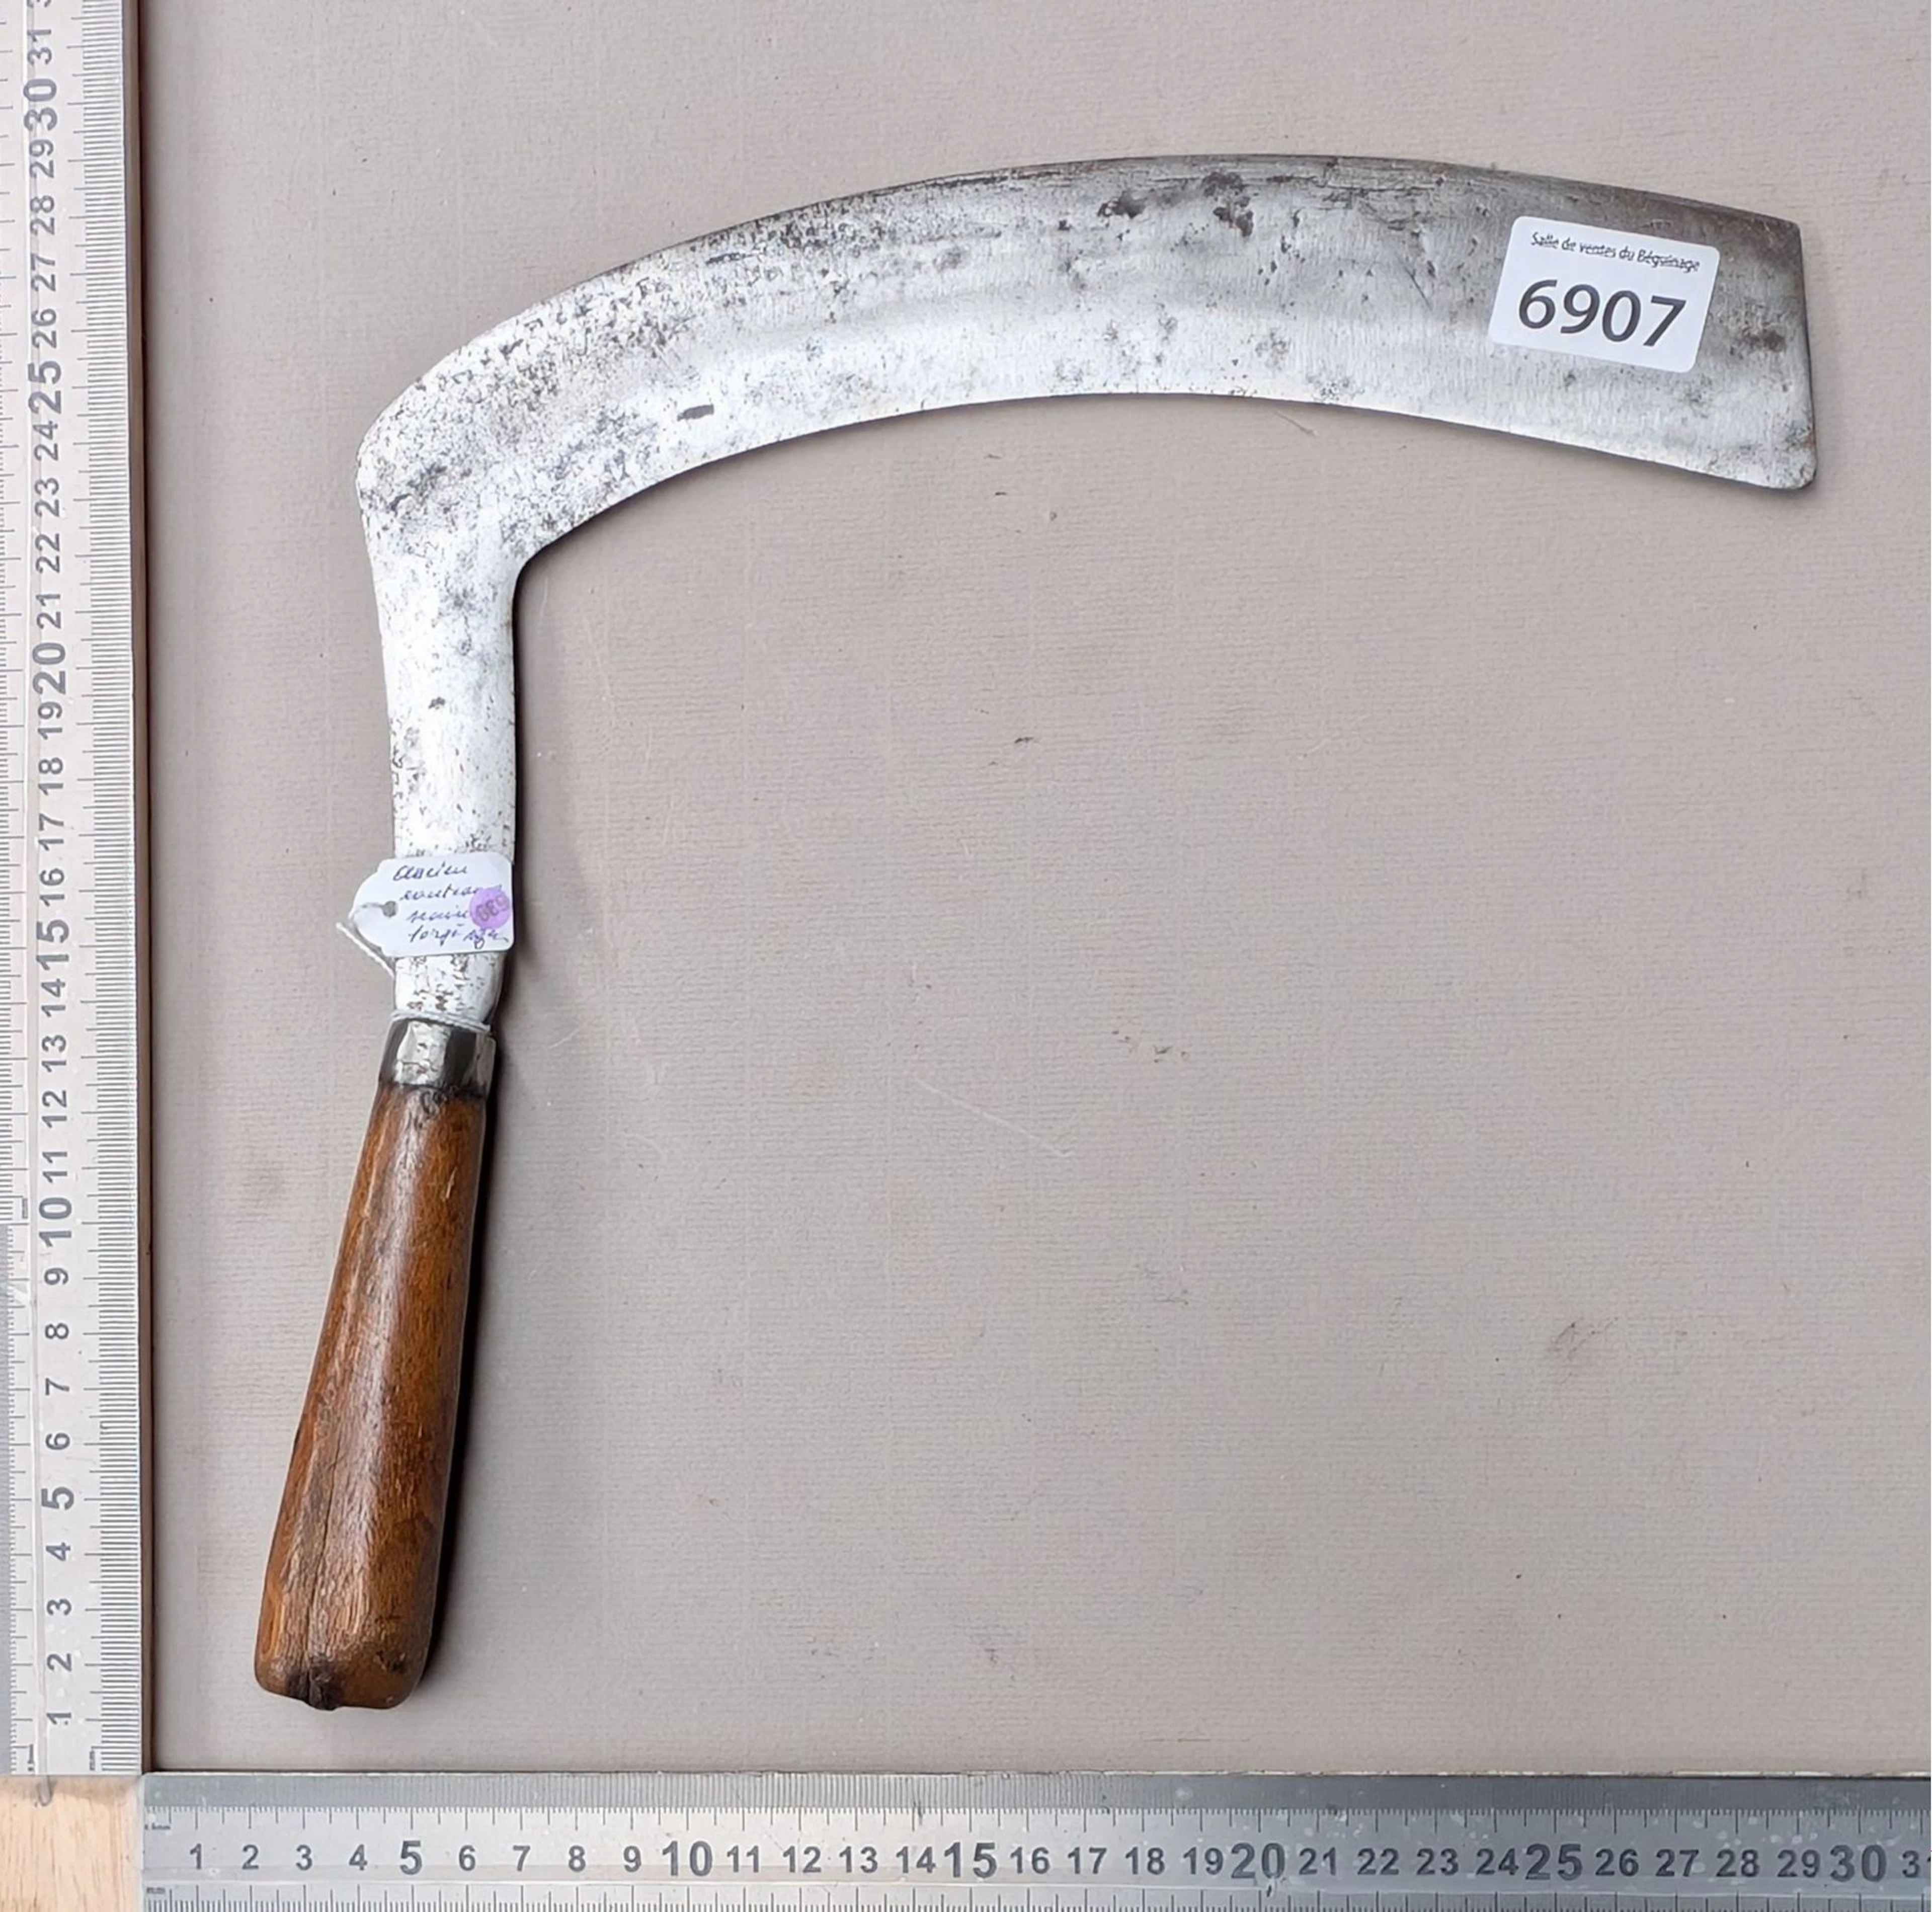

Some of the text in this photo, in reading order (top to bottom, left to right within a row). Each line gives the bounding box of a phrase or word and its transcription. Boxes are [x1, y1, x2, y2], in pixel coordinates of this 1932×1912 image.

[27, 29, 51, 65] 31
[23, 78, 57, 131] 30
[29, 138, 54, 178] 29
[30, 195, 55, 235] 28
[1531, 232, 1559, 249] Salle
[1561, 237, 1576, 251] de
[1579, 242, 1616, 258] ventes
[1619, 246, 1635, 261] du
[31, 253, 56, 292] 27
[31, 308, 57, 349] 26
[1519, 279, 1686, 347] 6907
[28, 360, 62, 415] 25
[32, 420, 58, 461] 24
[35, 477, 59, 518] 23
[35, 532, 60, 573] 22
[36, 593, 61, 629] 21
[32, 643, 65, 695] 20
[37, 701, 63, 740] 19
[38, 757, 64, 796] 18
[38, 813, 64, 851] 17
[39, 868, 65, 907] 16
[36, 919, 69, 971] 15
[41, 978, 66, 1017] 14
[41, 1034, 67, 1073] 13
[42, 1090, 67, 1128] 12
[42, 1151, 68, 1183] 11
[39, 1197, 72, 1247] 10
[44, 1267, 69, 1286] 9
[45, 1323, 69, 1340] 8
[45, 1378, 70, 1396] 7
[45, 1432, 70, 1451] 6
[41, 1487, 74, 1510] 5
[46, 1542, 71, 1561] 4
[46, 1598, 72, 1617] 3
[46, 1652, 72, 1673] 2
[46, 1712, 72, 1725] 1
[189, 1840, 1931, 1882] 1 2 3 4 5 6 7 8 9 10 11 12 13 14 15 16 17 18 19 20 21 22 23 24 25 26 27 28 29 30 3
